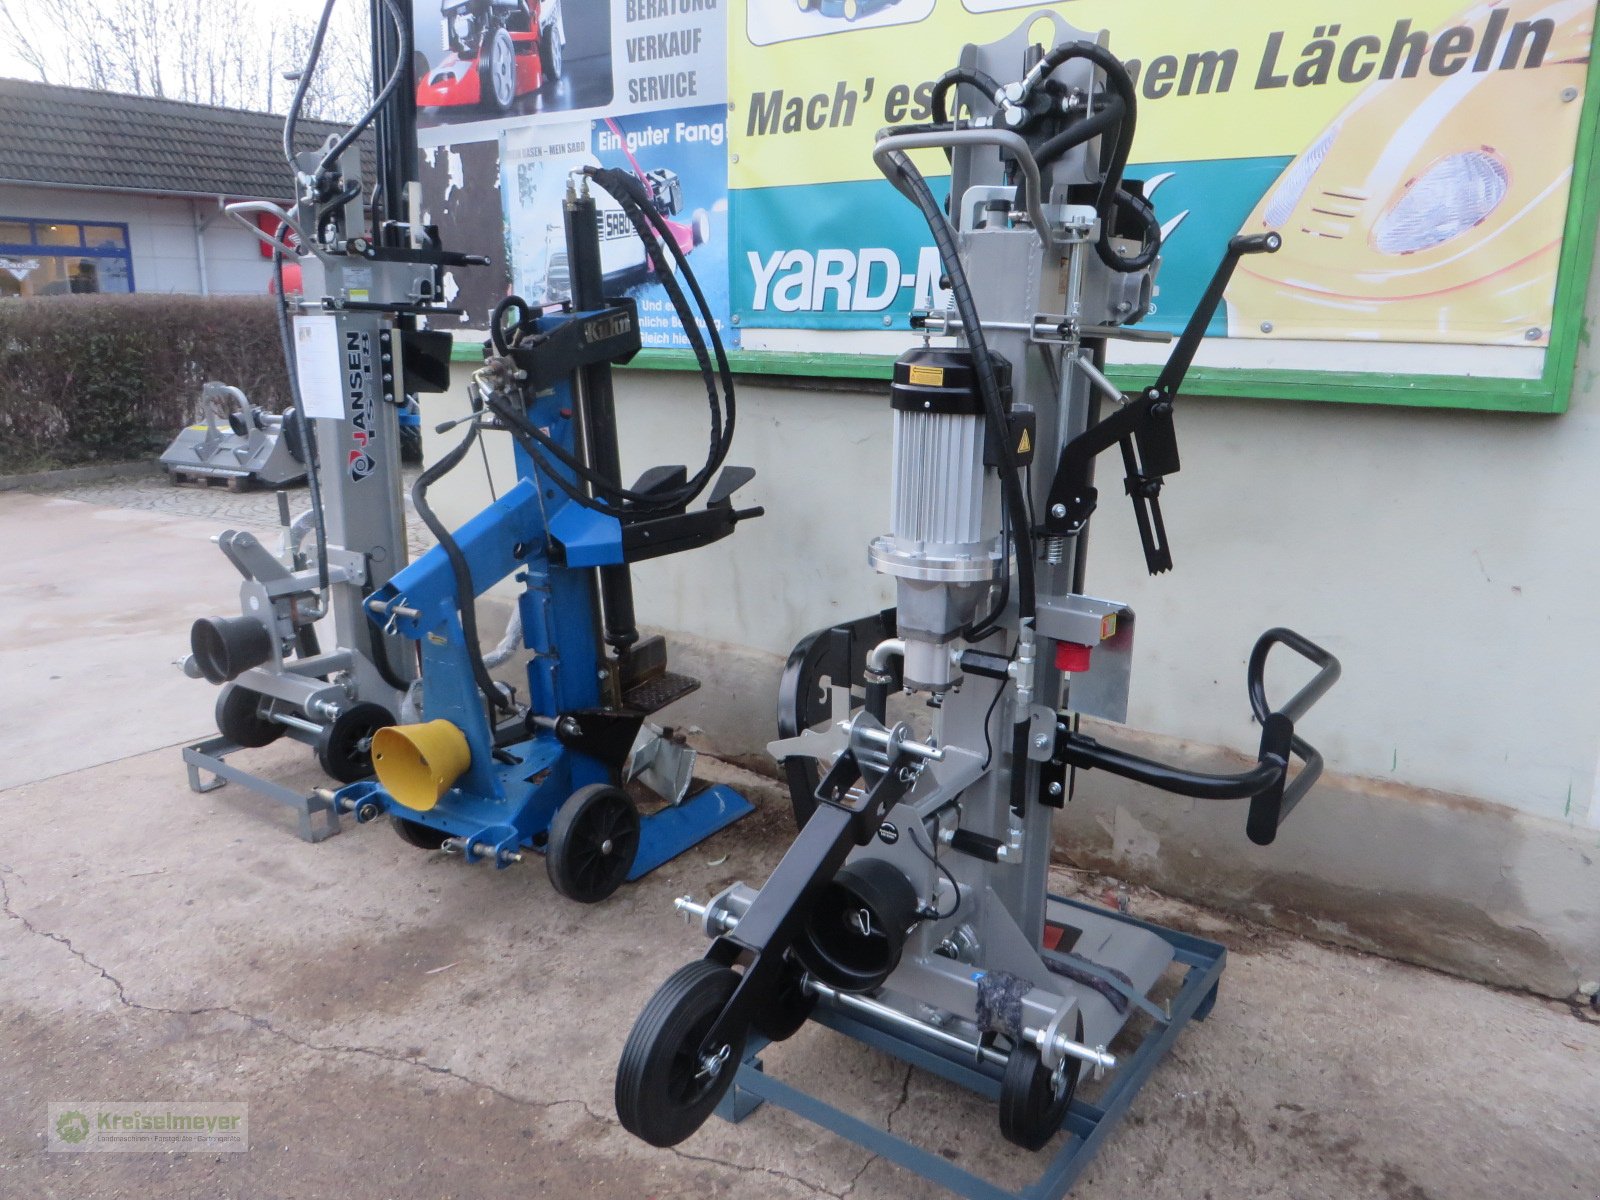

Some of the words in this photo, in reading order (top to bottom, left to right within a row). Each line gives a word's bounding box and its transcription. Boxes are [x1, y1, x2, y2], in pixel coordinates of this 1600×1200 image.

[626, 27, 702, 63] VERKAUF
[1254, 7, 1556, 90] Lächeln
[628, 70, 697, 104] SERVICE
[884, 81, 936, 124] es
[549, 143, 566, 155] MEIN
[567, 141, 586, 153] SABO
[598, 131, 622, 151] Ein
[626, 126, 670, 153] guter
[607, 213, 631, 236] SABO
[642, 300, 662, 311] Und
[346, 331, 368, 447] JANSEN
